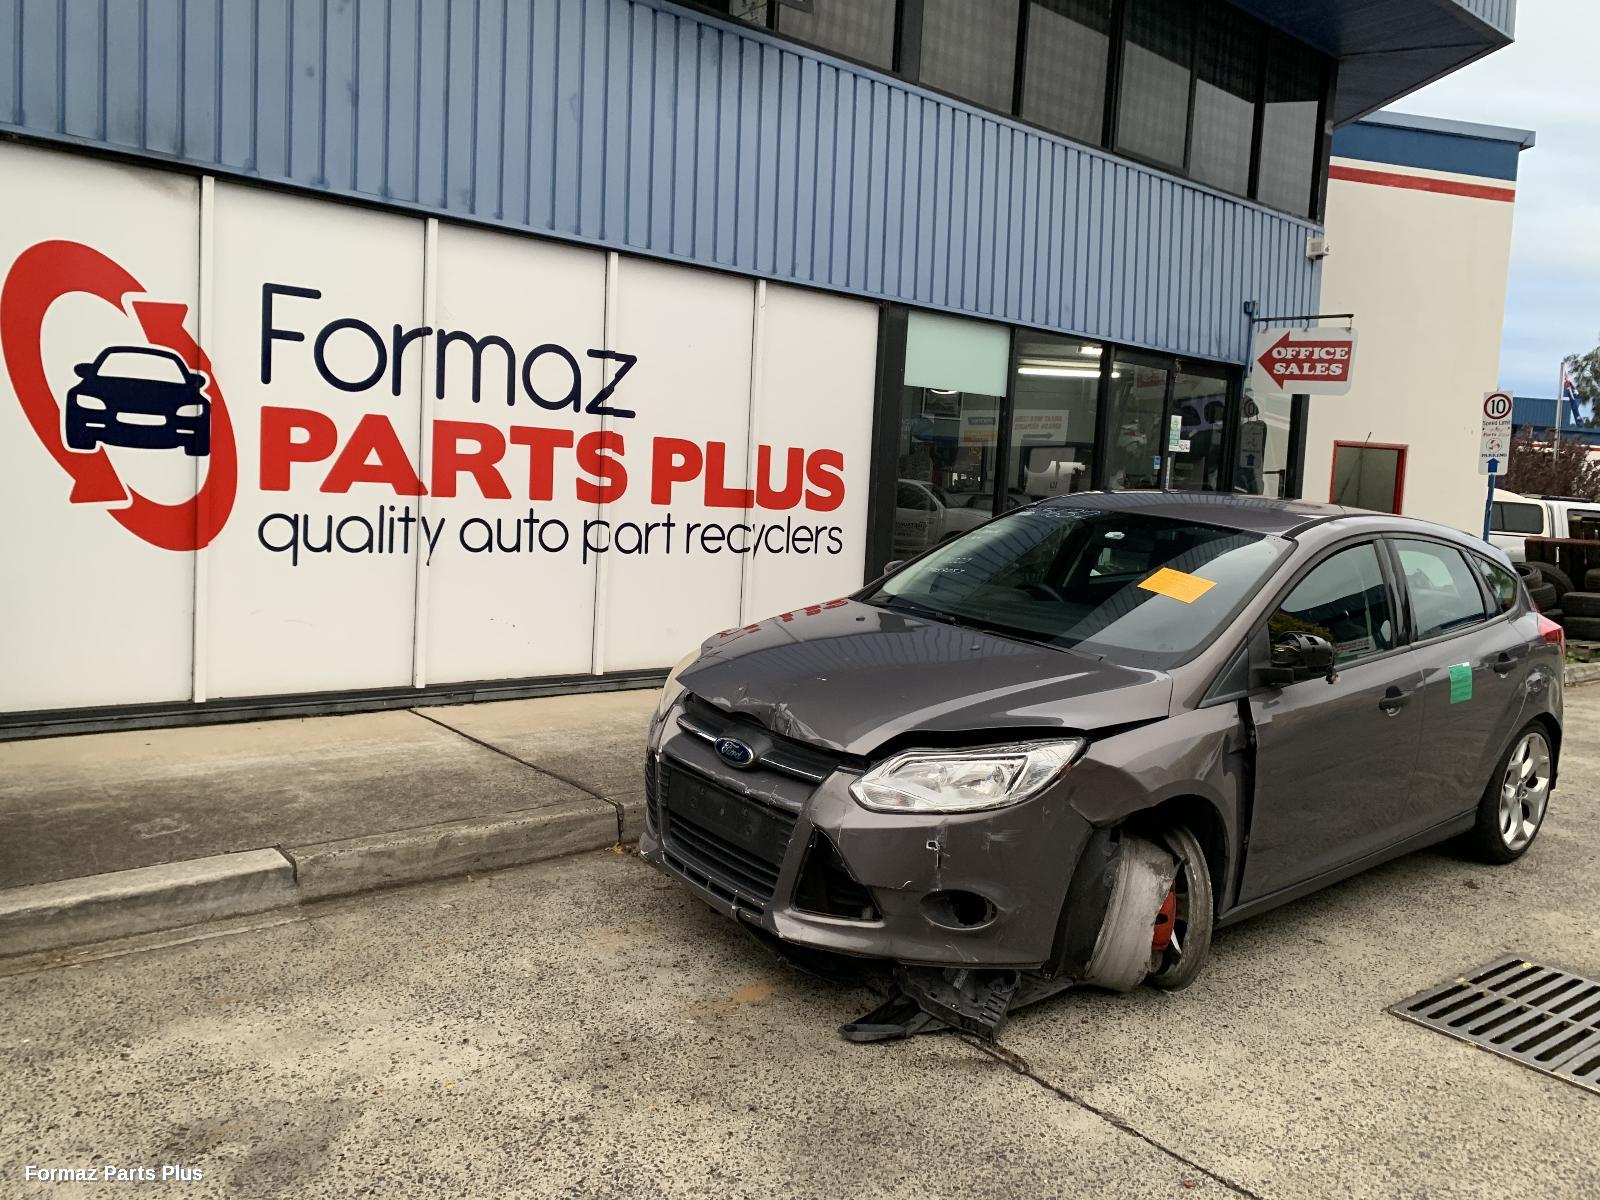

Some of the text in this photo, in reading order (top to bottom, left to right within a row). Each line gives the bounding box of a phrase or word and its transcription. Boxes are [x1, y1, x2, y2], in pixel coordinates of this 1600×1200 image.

[260, 282, 638, 419] Formaz
[1271, 347, 1349, 360] OFFICE
[1273, 362, 1343, 376] SALES
[1491, 398, 1506, 415] 10
[259, 406, 846, 513] PARTS PLUS
[258, 504, 843, 567] quality auto part recyclers
[721, 741, 744, 760] Ford
